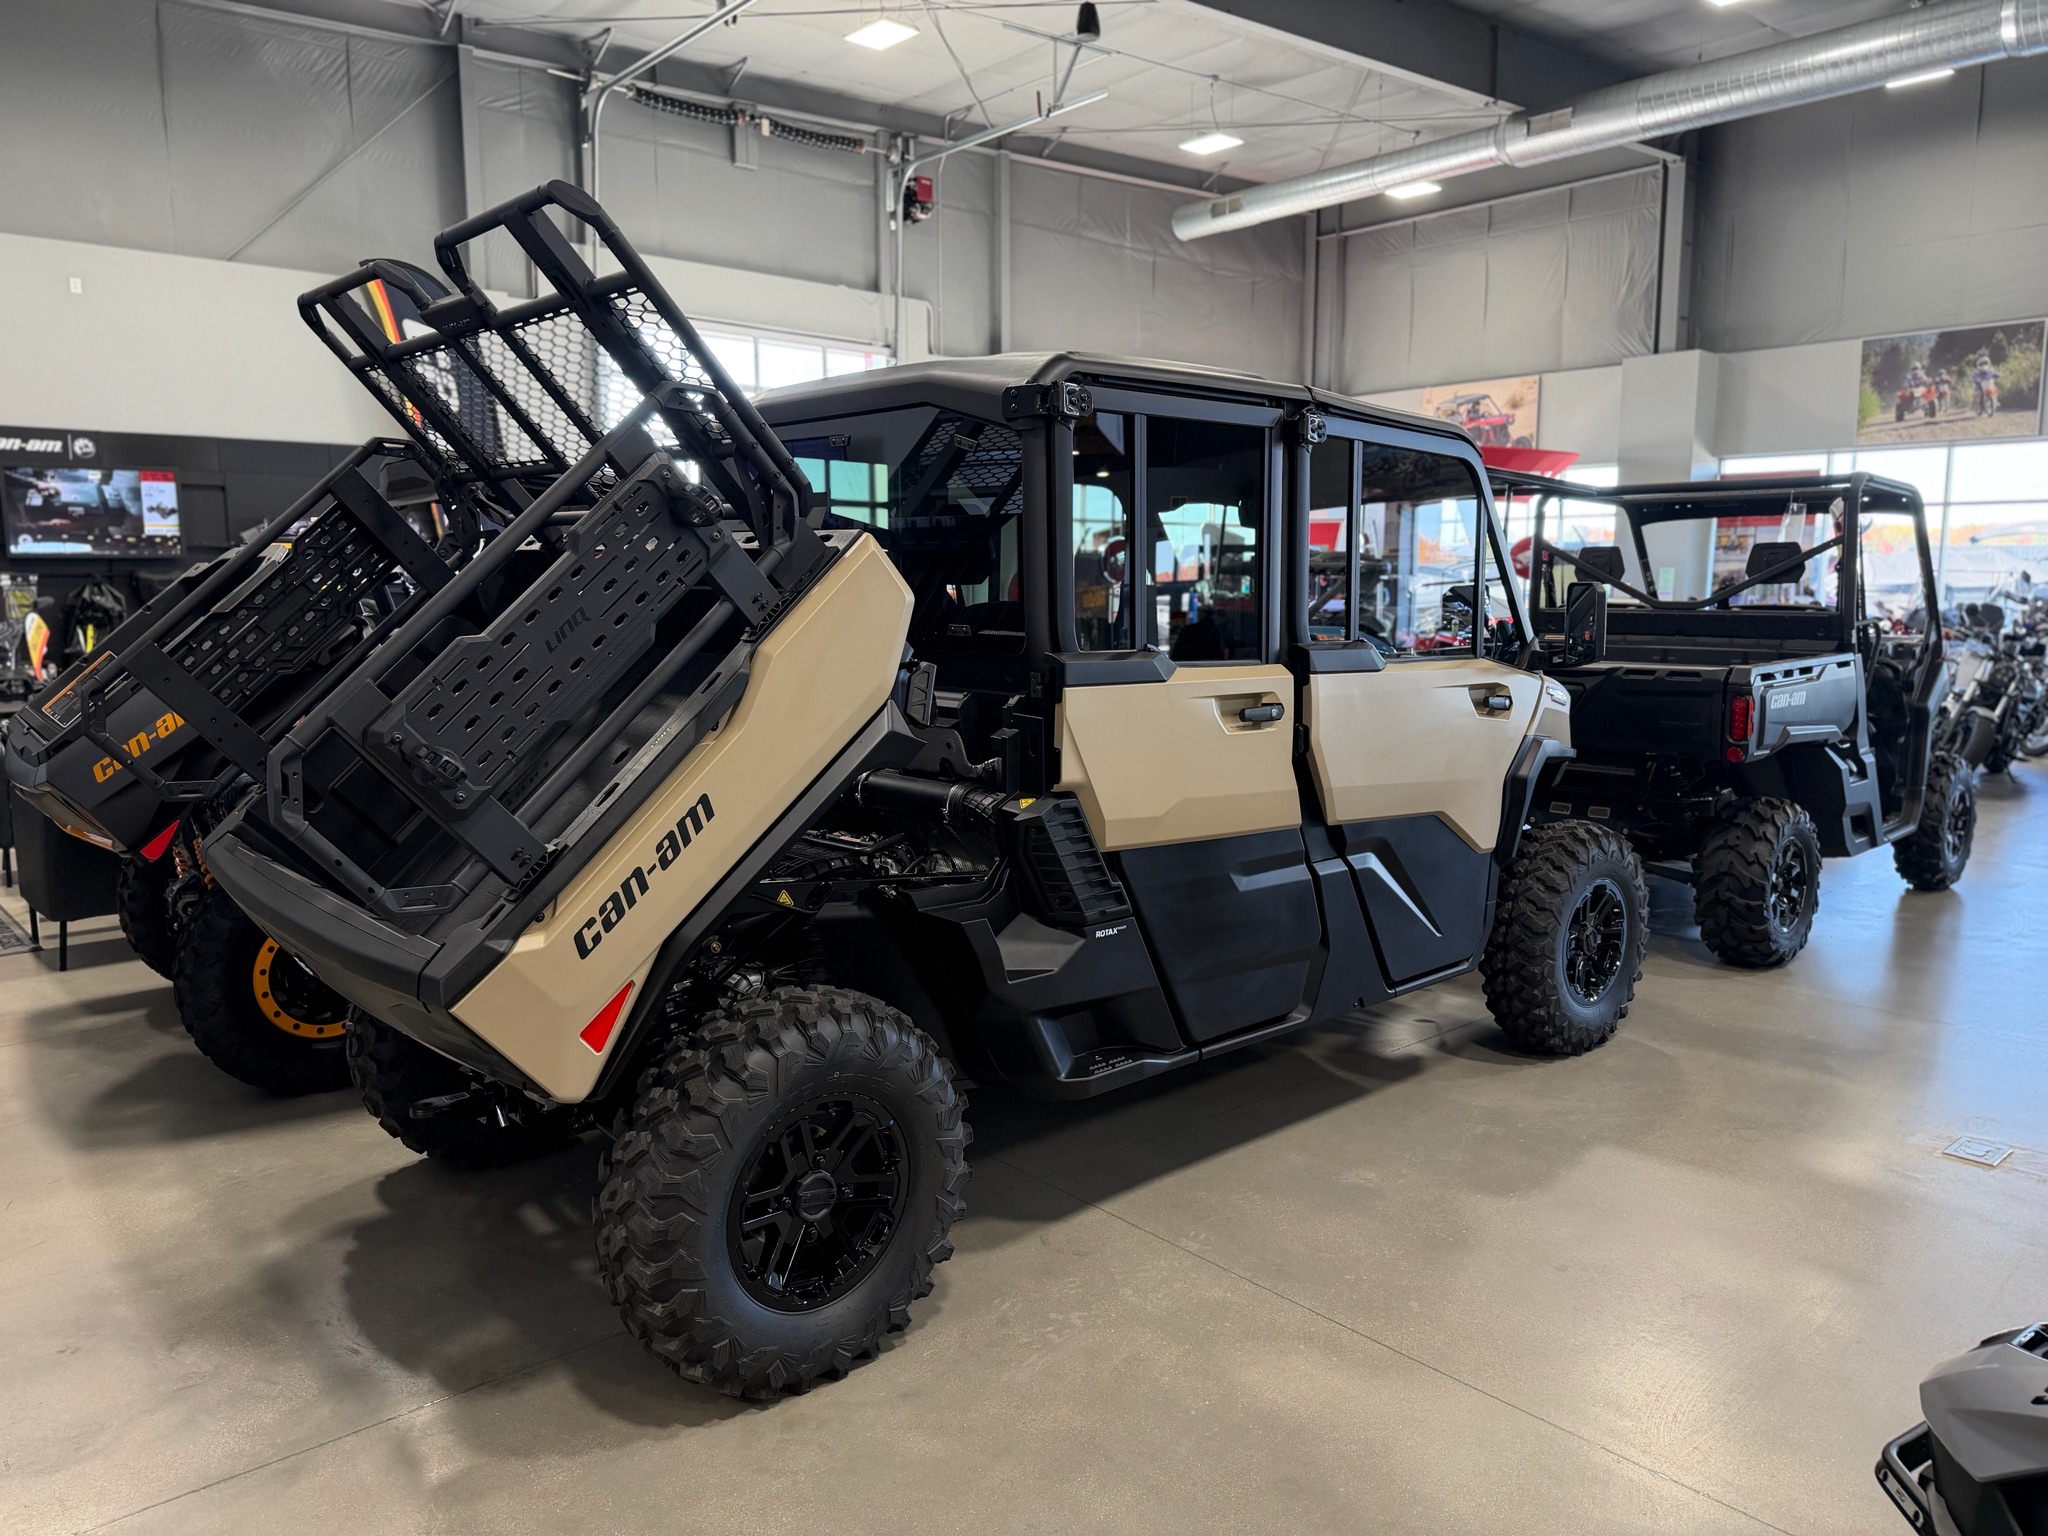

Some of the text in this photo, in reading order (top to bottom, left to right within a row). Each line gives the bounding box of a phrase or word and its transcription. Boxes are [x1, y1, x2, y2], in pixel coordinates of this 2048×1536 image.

[1770, 691, 1806, 709] can-am
[573, 793, 715, 960] can-am
[1096, 927, 1117, 938] ROTAX
